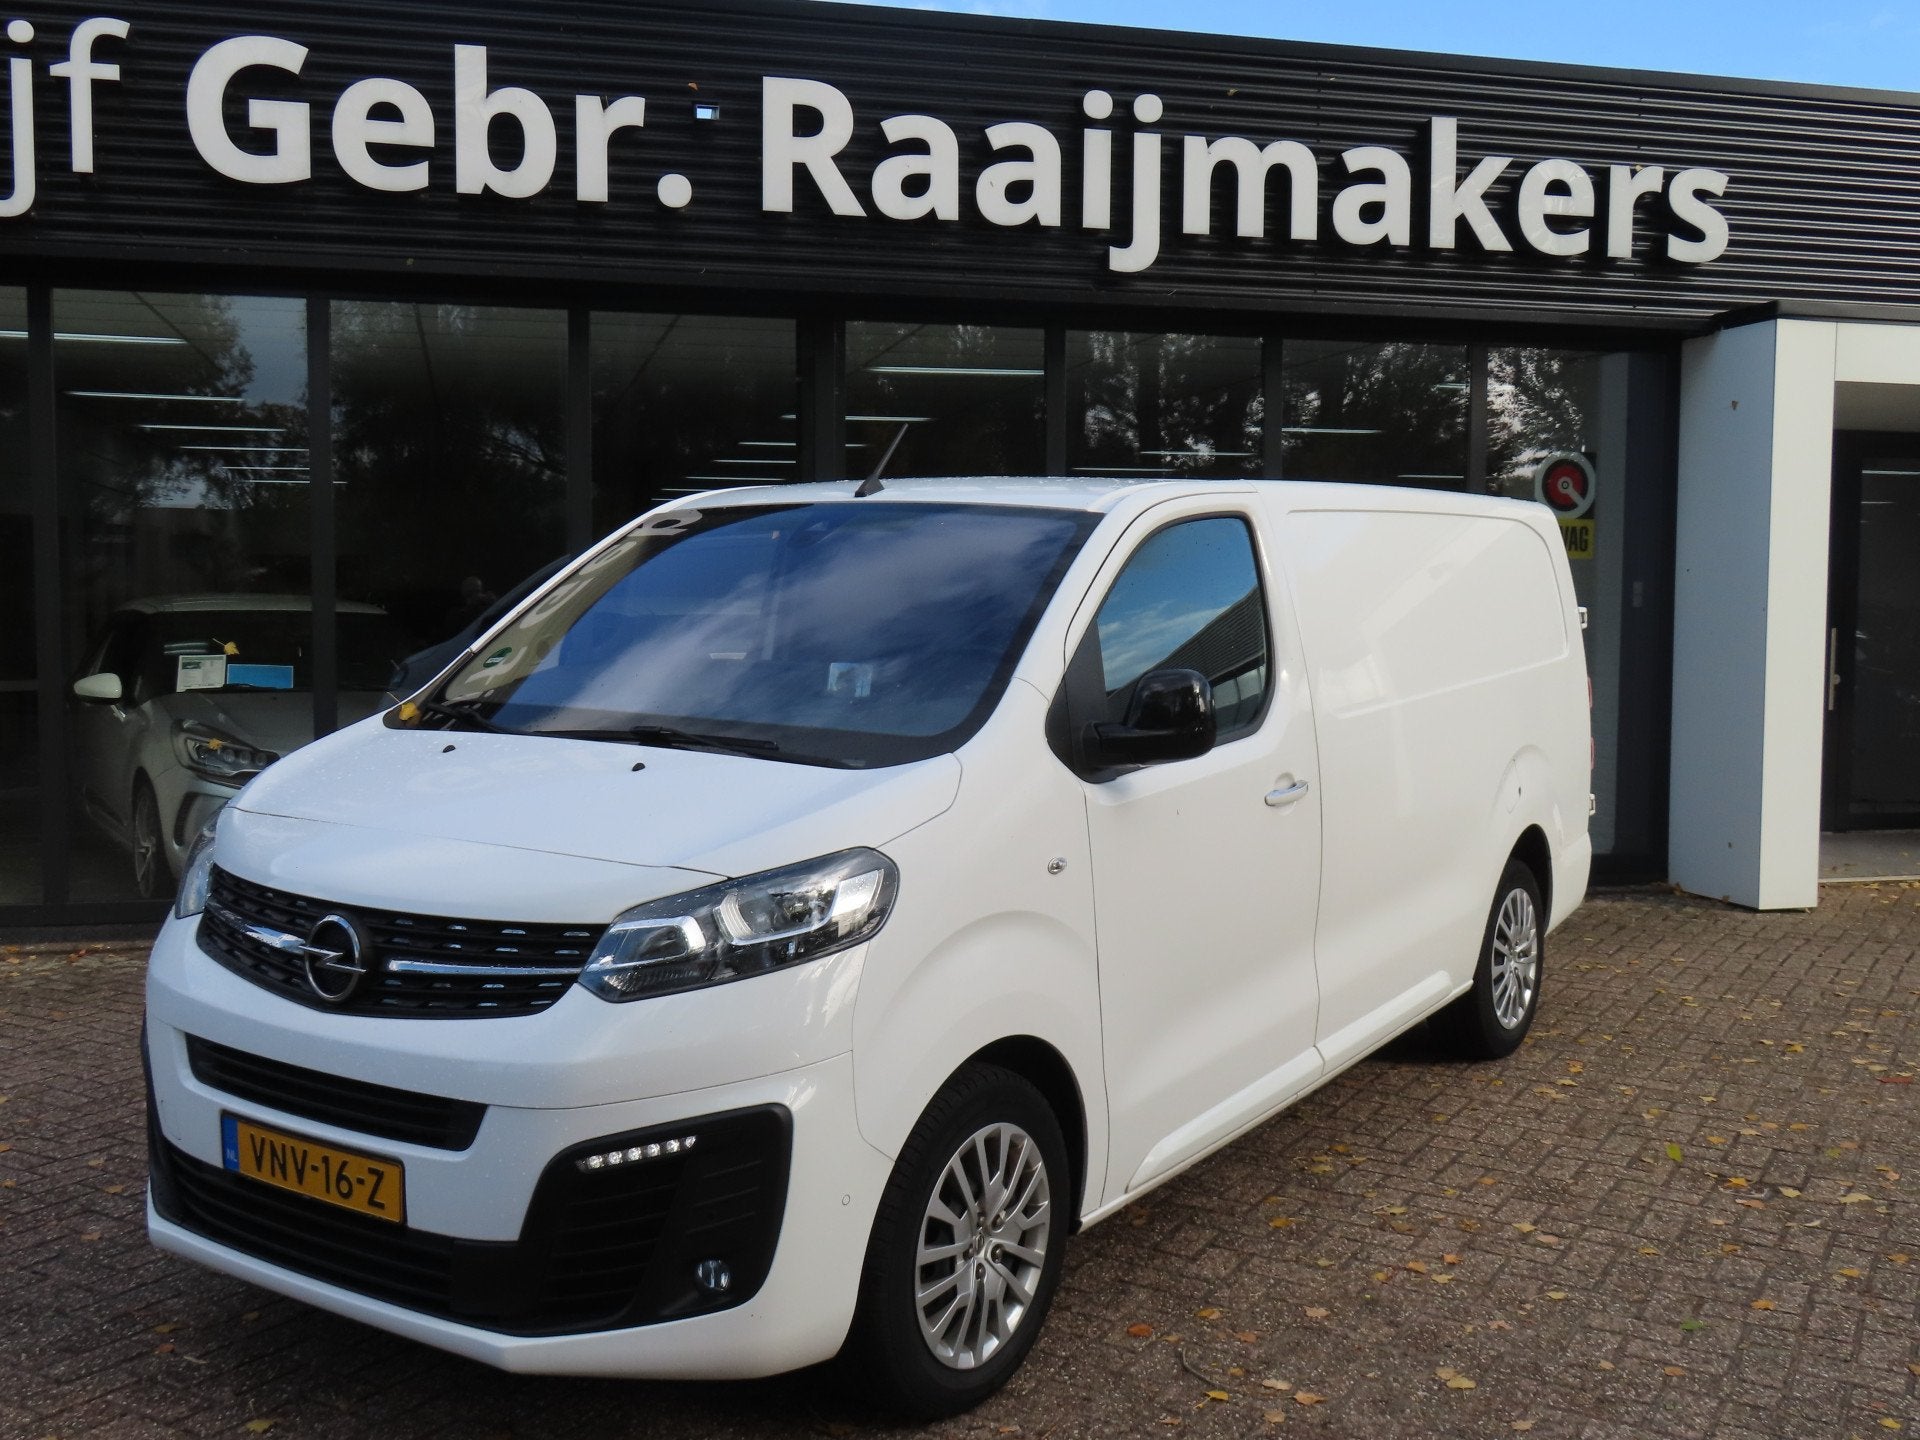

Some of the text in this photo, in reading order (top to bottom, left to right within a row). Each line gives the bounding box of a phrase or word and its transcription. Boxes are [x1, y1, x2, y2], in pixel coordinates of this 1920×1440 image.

[186, 35, 692, 208] Gebr.
[762, 76, 1730, 273] Raaijmakers
[250, 1133, 385, 1210] VNV-16-Z
